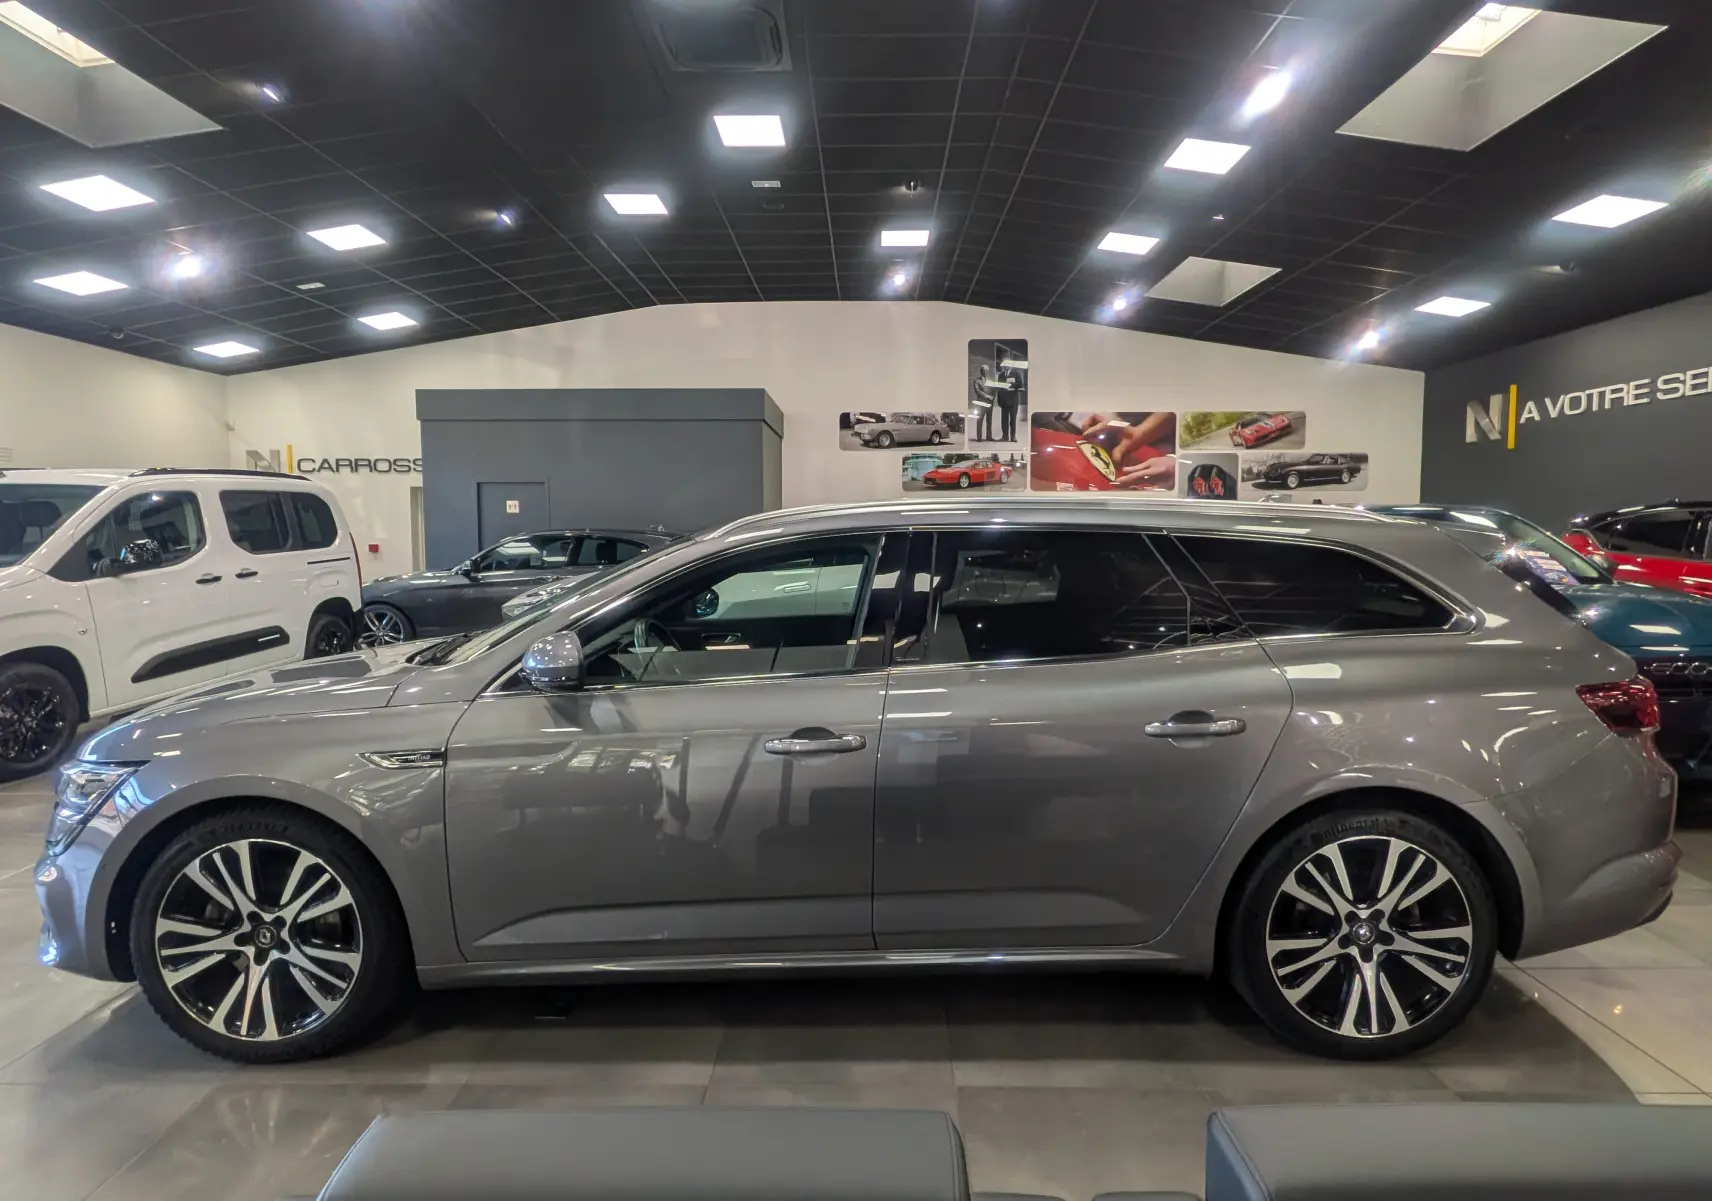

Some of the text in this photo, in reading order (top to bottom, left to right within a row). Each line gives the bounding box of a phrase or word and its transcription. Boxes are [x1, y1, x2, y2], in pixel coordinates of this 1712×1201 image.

[1519, 366, 1712, 424] A VOTRE SE
